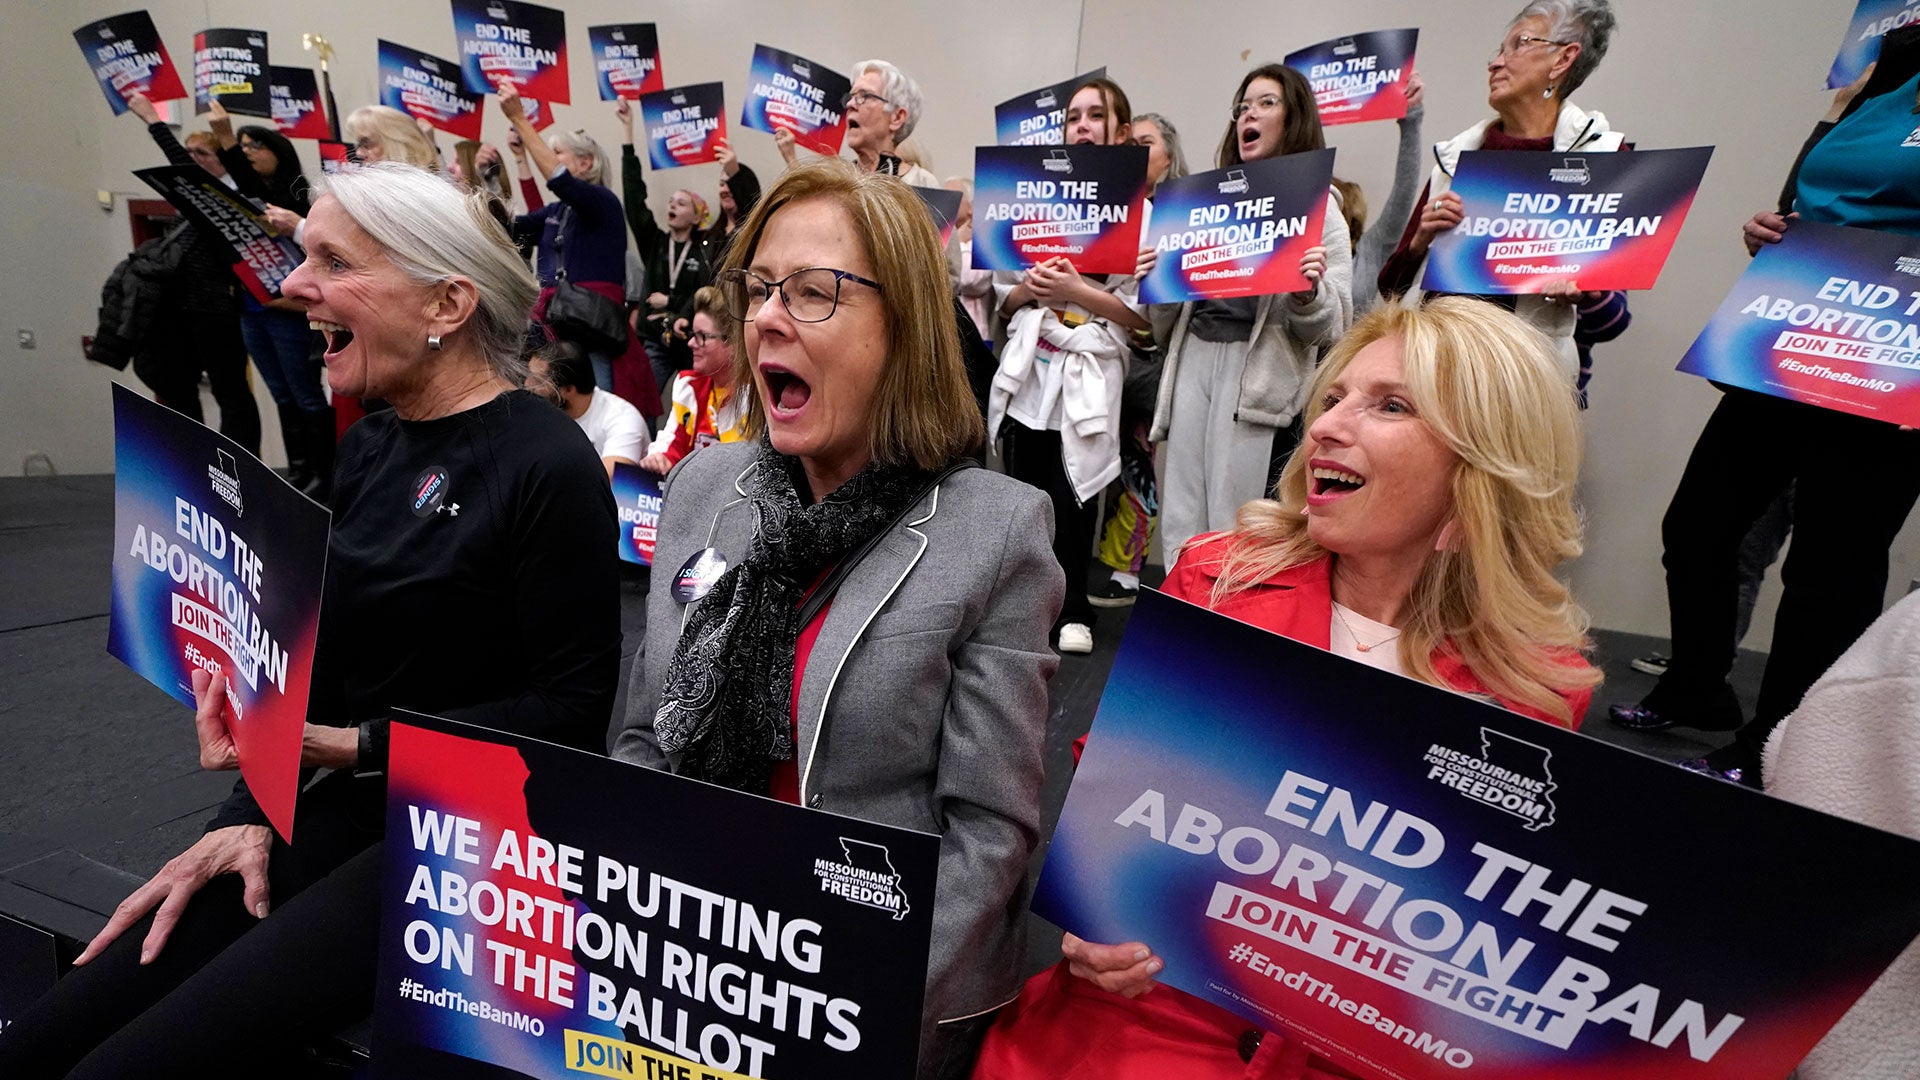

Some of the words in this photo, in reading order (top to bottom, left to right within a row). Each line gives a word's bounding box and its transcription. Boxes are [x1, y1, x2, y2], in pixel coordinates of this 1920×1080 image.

[475, 23, 500, 39] END
[500, 25, 531, 44] THE
[463, 40, 521, 58] ABORTION
[523, 46, 558, 66] BAN
[604, 45, 621, 58] END
[621, 44, 639, 58] THE
[635, 58, 655, 70] BAN
[222, 61, 261, 76] RIGHTS
[403, 65, 430, 84] END
[431, 75, 457, 94] THE
[1311, 61, 1343, 79] END
[1345, 55, 1377, 73] THE
[1364, 68, 1401, 87] BAN
[385, 74, 447, 103] ABORTION
[447, 92, 476, 114] BAN
[772, 72, 799, 90] END
[800, 81, 826, 104] THE
[662, 109, 682, 124] END
[682, 105, 701, 120] THE
[752, 83, 813, 113] ABORTION
[813, 103, 841, 126] BAN
[652, 121, 697, 139] ABORTION
[697, 117, 719, 132] BAN
[1020, 114, 1047, 134] END
[1048, 108, 1066, 125] TH
[1016, 181, 1056, 199] END
[1060, 181, 1099, 200] THE
[1503, 193, 1561, 214] END
[1567, 193, 1623, 214] THE
[984, 203, 1082, 221] ABORTION
[1086, 204, 1128, 223] BAN
[1189, 204, 1230, 227] END
[1234, 196, 1275, 220] THE
[1017, 227, 1038, 238] JOIN
[1042, 225, 1061, 234] THE
[1064, 222, 1095, 232] FIGHT
[1155, 222, 1256, 253] ABORTION
[1260, 215, 1307, 241] BAN
[1453, 216, 1593, 239] ABORTION
[1596, 215, 1661, 238] BAN
[1021, 243, 1083, 255] #EndTheBanMO
[1186, 252, 1209, 267] JOIN
[1213, 247, 1232, 259] THE
[1235, 240, 1268, 254] FIGHT
[1492, 244, 1524, 257] JOIN
[1529, 243, 1556, 253] THE
[1560, 237, 1606, 251] FIGHT
[1190, 267, 1254, 282] #EndTheBanMO
[1495, 263, 1581, 275] #EndTheBanMO
[1816, 276, 1900, 310] END
[1782, 336, 1829, 352] JOIN
[1833, 342, 1874, 358] THE
[1778, 357, 1896, 393] #EndTheBanMO
[212, 480, 240, 509] FREEDOM
[415, 477, 441, 510] SIGNED
[175, 496, 227, 561] END
[230, 531, 264, 605] THE
[129, 524, 249, 637] ABORTION
[251, 613, 289, 696] BAN
[177, 601, 210, 634] JOIN
[213, 617, 233, 650] THE
[234, 636, 255, 679] FIGHT
[1423, 754, 1446, 767] FOR
[1446, 759, 1537, 802] CONSTITUTIONAL
[1428, 744, 1546, 793] MISSOURIANS
[1427, 765, 1546, 820] FREEDOM
[814, 858, 894, 886] MISSOURIANS
[1263, 769, 1446, 870] END
[1464, 842, 1648, 953] THE
[408, 805, 481, 865] WE
[491, 829, 584, 893] ARE
[596, 855, 823, 975] PUTTING
[814, 868, 829, 878] FOR
[829, 872, 893, 894] CONSTITUTIONAL
[821, 878, 901, 909] FREEDOM
[1113, 789, 1535, 996] ABORTION
[1537, 957, 1745, 1063] BAN
[405, 864, 648, 979] ABORTION
[662, 940, 862, 1053] RIGHTS
[1221, 894, 1319, 944] JOIN
[1331, 933, 1414, 981] THE
[1424, 968, 1563, 1033] FIGHT
[399, 977, 545, 1038] #EndTheBanMO
[404, 920, 475, 977] ON
[486, 938, 576, 1010] THE
[587, 974, 776, 1079] BALLOT
[1228, 941, 1474, 1070] #EndTheBanMO
[1210, 982, 1223, 992] Paid
[1223, 988, 1232, 996] for
[1232, 992, 1240, 1000] by
[1240, 997, 1275, 1017] Missourians
[1275, 1013, 1284, 1021] for
[1285, 1019, 1327, 1043] Constitutional
[1326, 1039, 1356, 1058] Freedom,
[1357, 1055, 1382, 1071] Michael
[576, 1039, 633, 1075] JOIN
